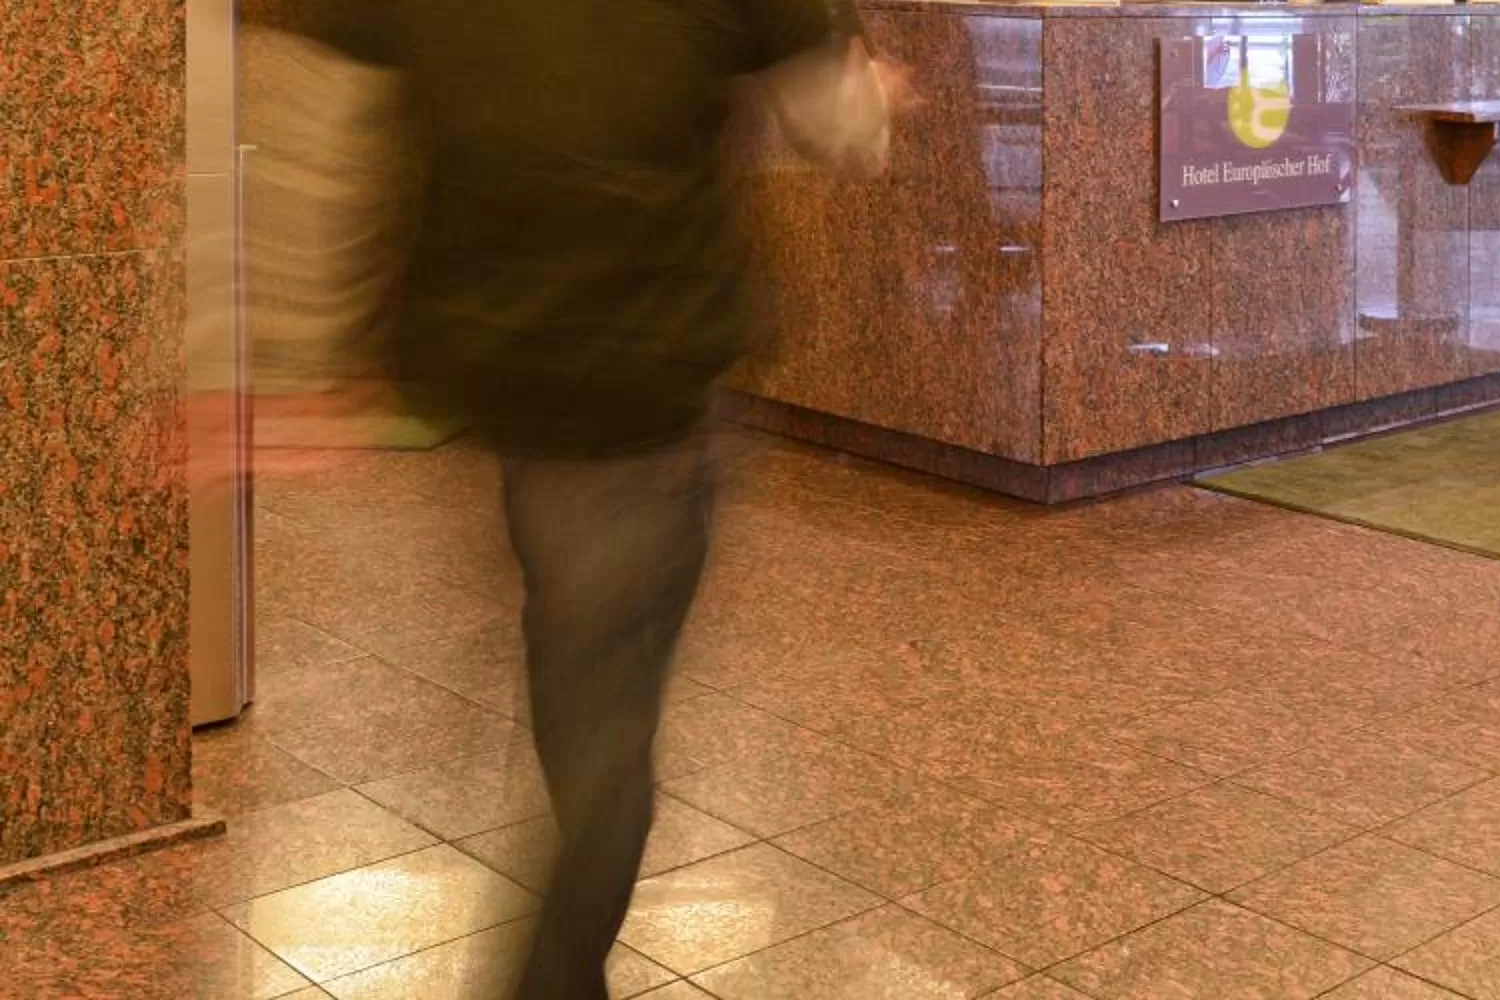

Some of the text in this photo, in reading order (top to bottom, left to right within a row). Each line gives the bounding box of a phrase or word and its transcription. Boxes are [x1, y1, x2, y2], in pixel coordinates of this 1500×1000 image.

[1182, 153, 1332, 187] Hotel Europäischer Hof
